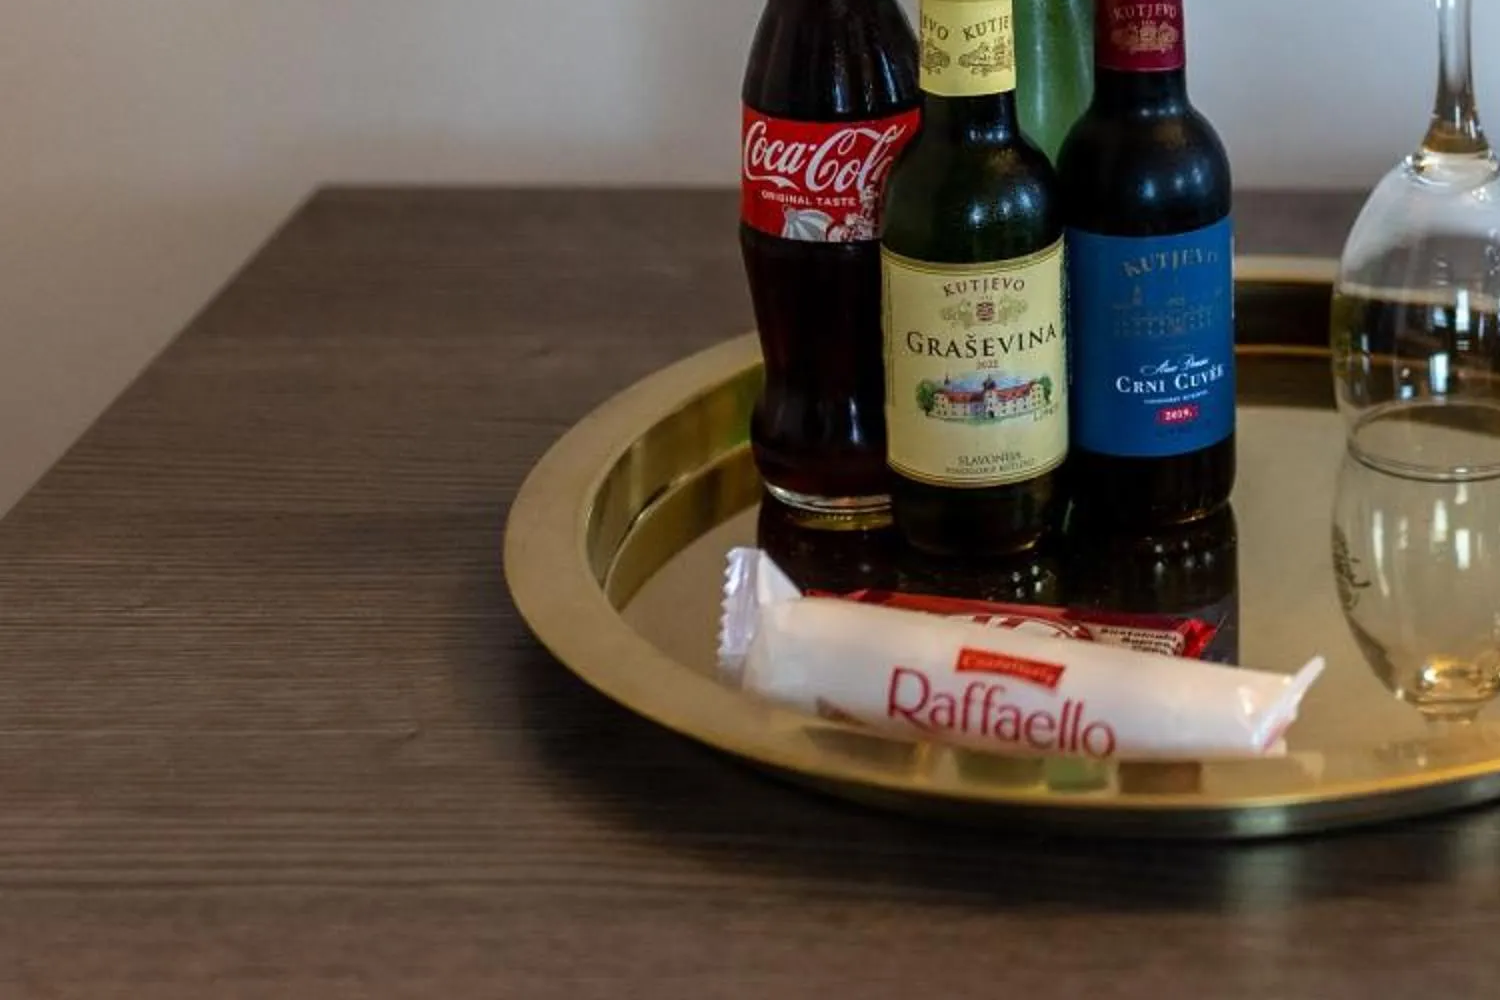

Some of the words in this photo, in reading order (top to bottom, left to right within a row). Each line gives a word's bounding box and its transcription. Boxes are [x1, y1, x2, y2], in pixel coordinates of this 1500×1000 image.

[761, 190, 811, 206] ORIGINAL
[815, 196, 858, 207] TASTE
[943, 277, 1025, 297] KUTJEVO
[907, 323, 1057, 359] GRAŠEVINA
[1115, 375, 1166, 394] CRNI
[888, 666, 1116, 759] Raffaello
